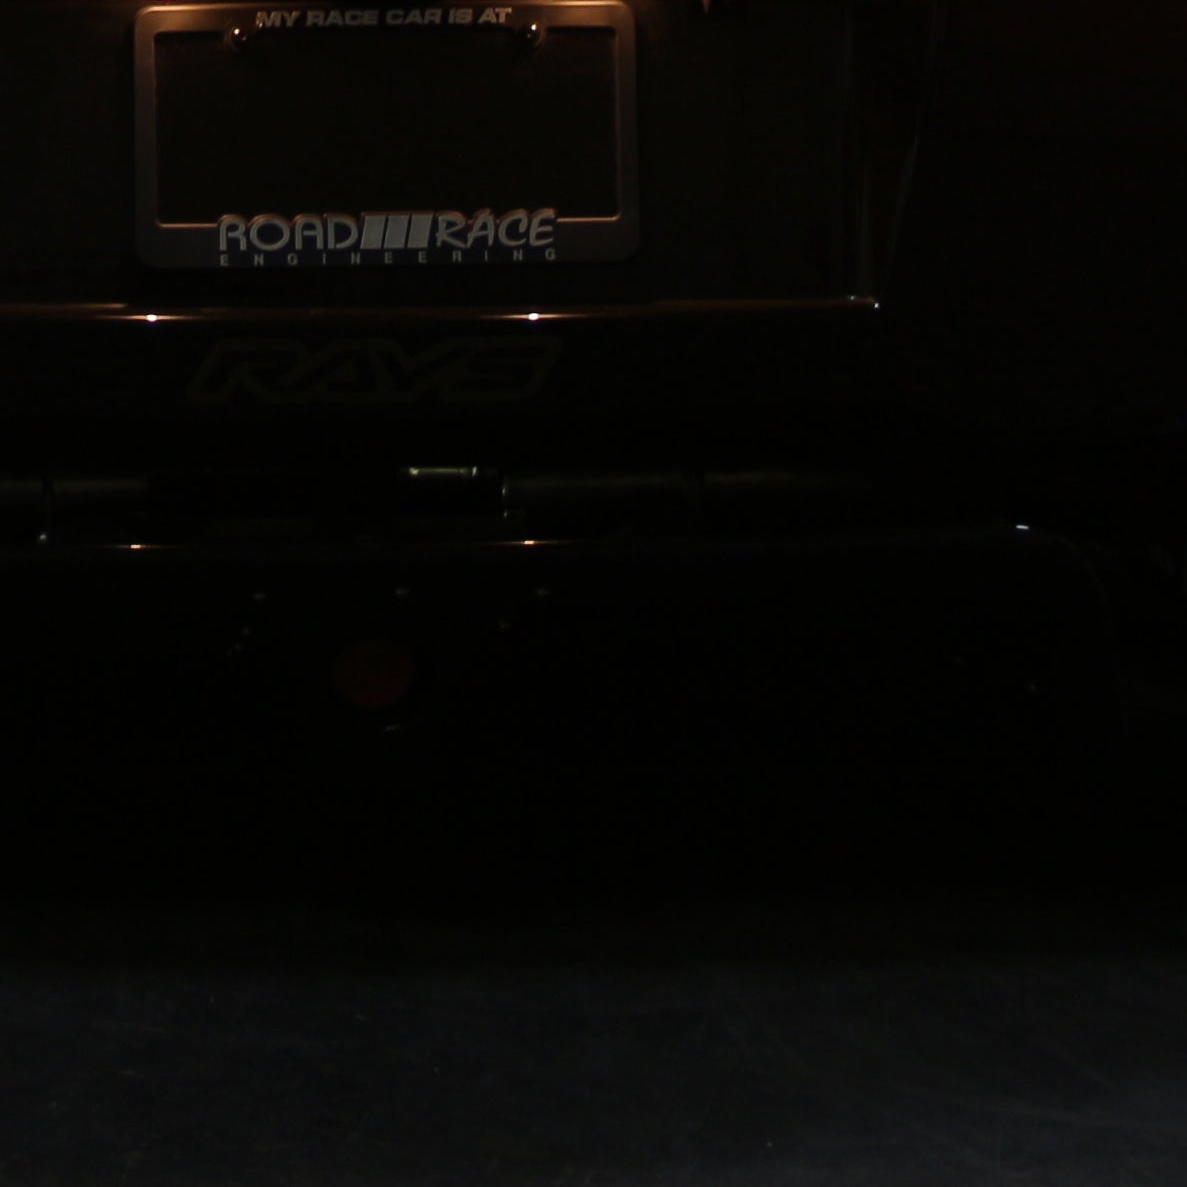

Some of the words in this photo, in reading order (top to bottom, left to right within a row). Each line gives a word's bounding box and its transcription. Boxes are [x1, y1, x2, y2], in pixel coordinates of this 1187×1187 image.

[255, 10, 300, 29] MY
[306, 8, 380, 27] RACE
[385, 8, 441, 26] CAR
[448, 8, 474, 25] IS
[478, 6, 513, 25] AT
[217, 214, 359, 251] ROAD
[435, 208, 558, 249] RACE
[219, 250, 557, 266] ENGINEERING
[186, 334, 564, 405] RAYS
